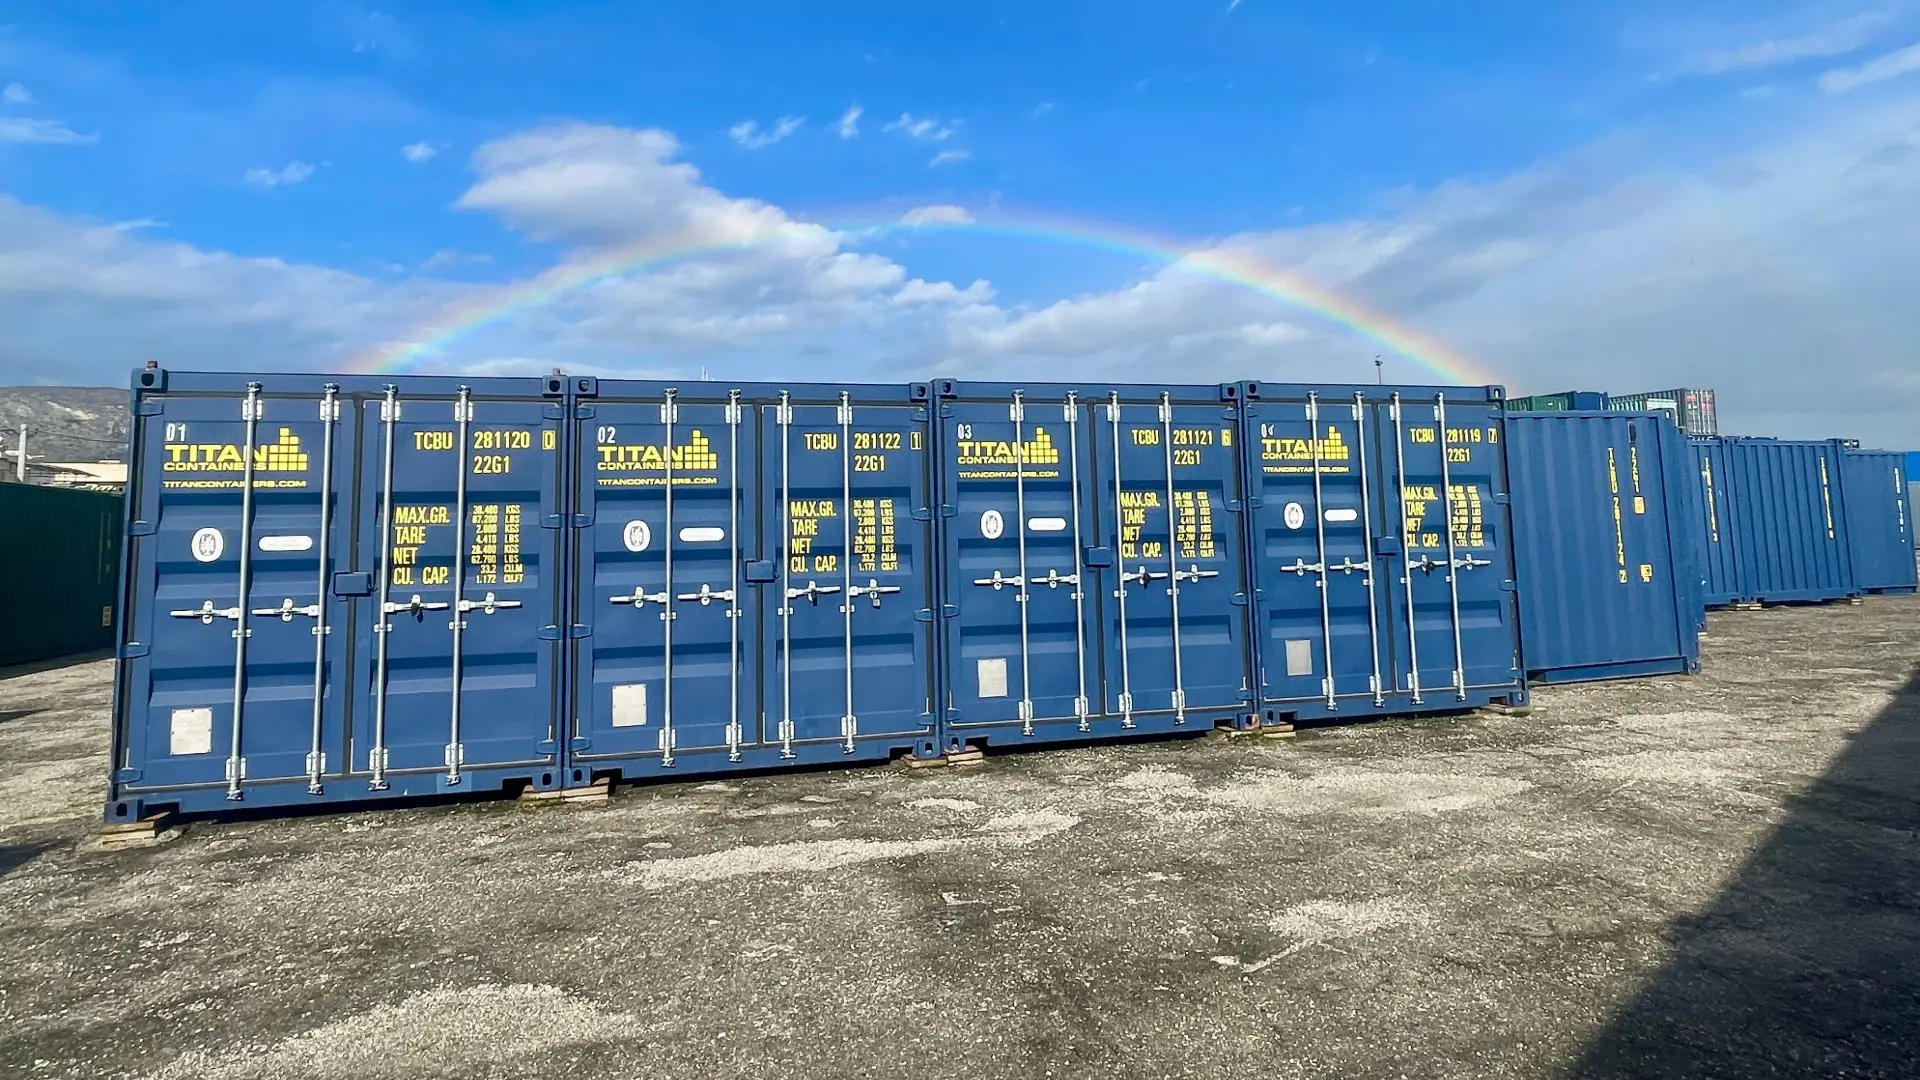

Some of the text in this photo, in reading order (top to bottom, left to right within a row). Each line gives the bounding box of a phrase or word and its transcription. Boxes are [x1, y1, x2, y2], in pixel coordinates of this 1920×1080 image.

[165, 423, 185, 441] 01
[598, 427, 615, 443] 02
[958, 424, 971, 439] 03
[1132, 430, 1159, 444] TCBU
[1174, 430, 1212, 445] 281121
[1410, 429, 1434, 442] TCBU
[1447, 429, 1480, 442] 281119
[414, 432, 452, 449] TCBU
[474, 431, 530, 448] 281120
[805, 434, 836, 449] TCBU
[854, 433, 900, 449] 281122
[1261, 439, 1323, 452] TITAN
[164, 444, 268, 462] TITAN
[597, 445, 684, 461] TITAN
[958, 442, 1030, 456] TITAN
[1448, 448, 1469, 461] 22G1
[474, 456, 509, 473] 22G1
[855, 455, 884, 471] 22G1
[1174, 450, 1200, 464] 22G1
[1631, 446, 1640, 492] 22G1
[1121, 493, 1160, 507] MAX.GR.
[1608, 447, 1618, 494] TCBU
[1613, 496, 1624, 566] 281124
[395, 507, 450, 523] MAX.GR.
[506, 505, 520, 514] KGS
[791, 501, 836, 517] MAX.GR.
[1406, 501, 1425, 515] TARE
[1123, 509, 1145, 524] TARE
[792, 519, 817, 535] TARE
[1123, 526, 1140, 541] NET
[395, 526, 426, 544] TARE
[504, 534, 520, 543] LBS
[1423, 534, 1439, 547] CAP.
[504, 544, 519, 554] KGS
[792, 538, 811, 554] NET
[1123, 543, 1162, 558] CU. CAP.
[394, 547, 418, 564] NET
[504, 554, 519, 564] LBS
[791, 556, 836, 572] CU. CAP.
[393, 567, 448, 584] CU. CAP.
[476, 574, 496, 583] 1.172
